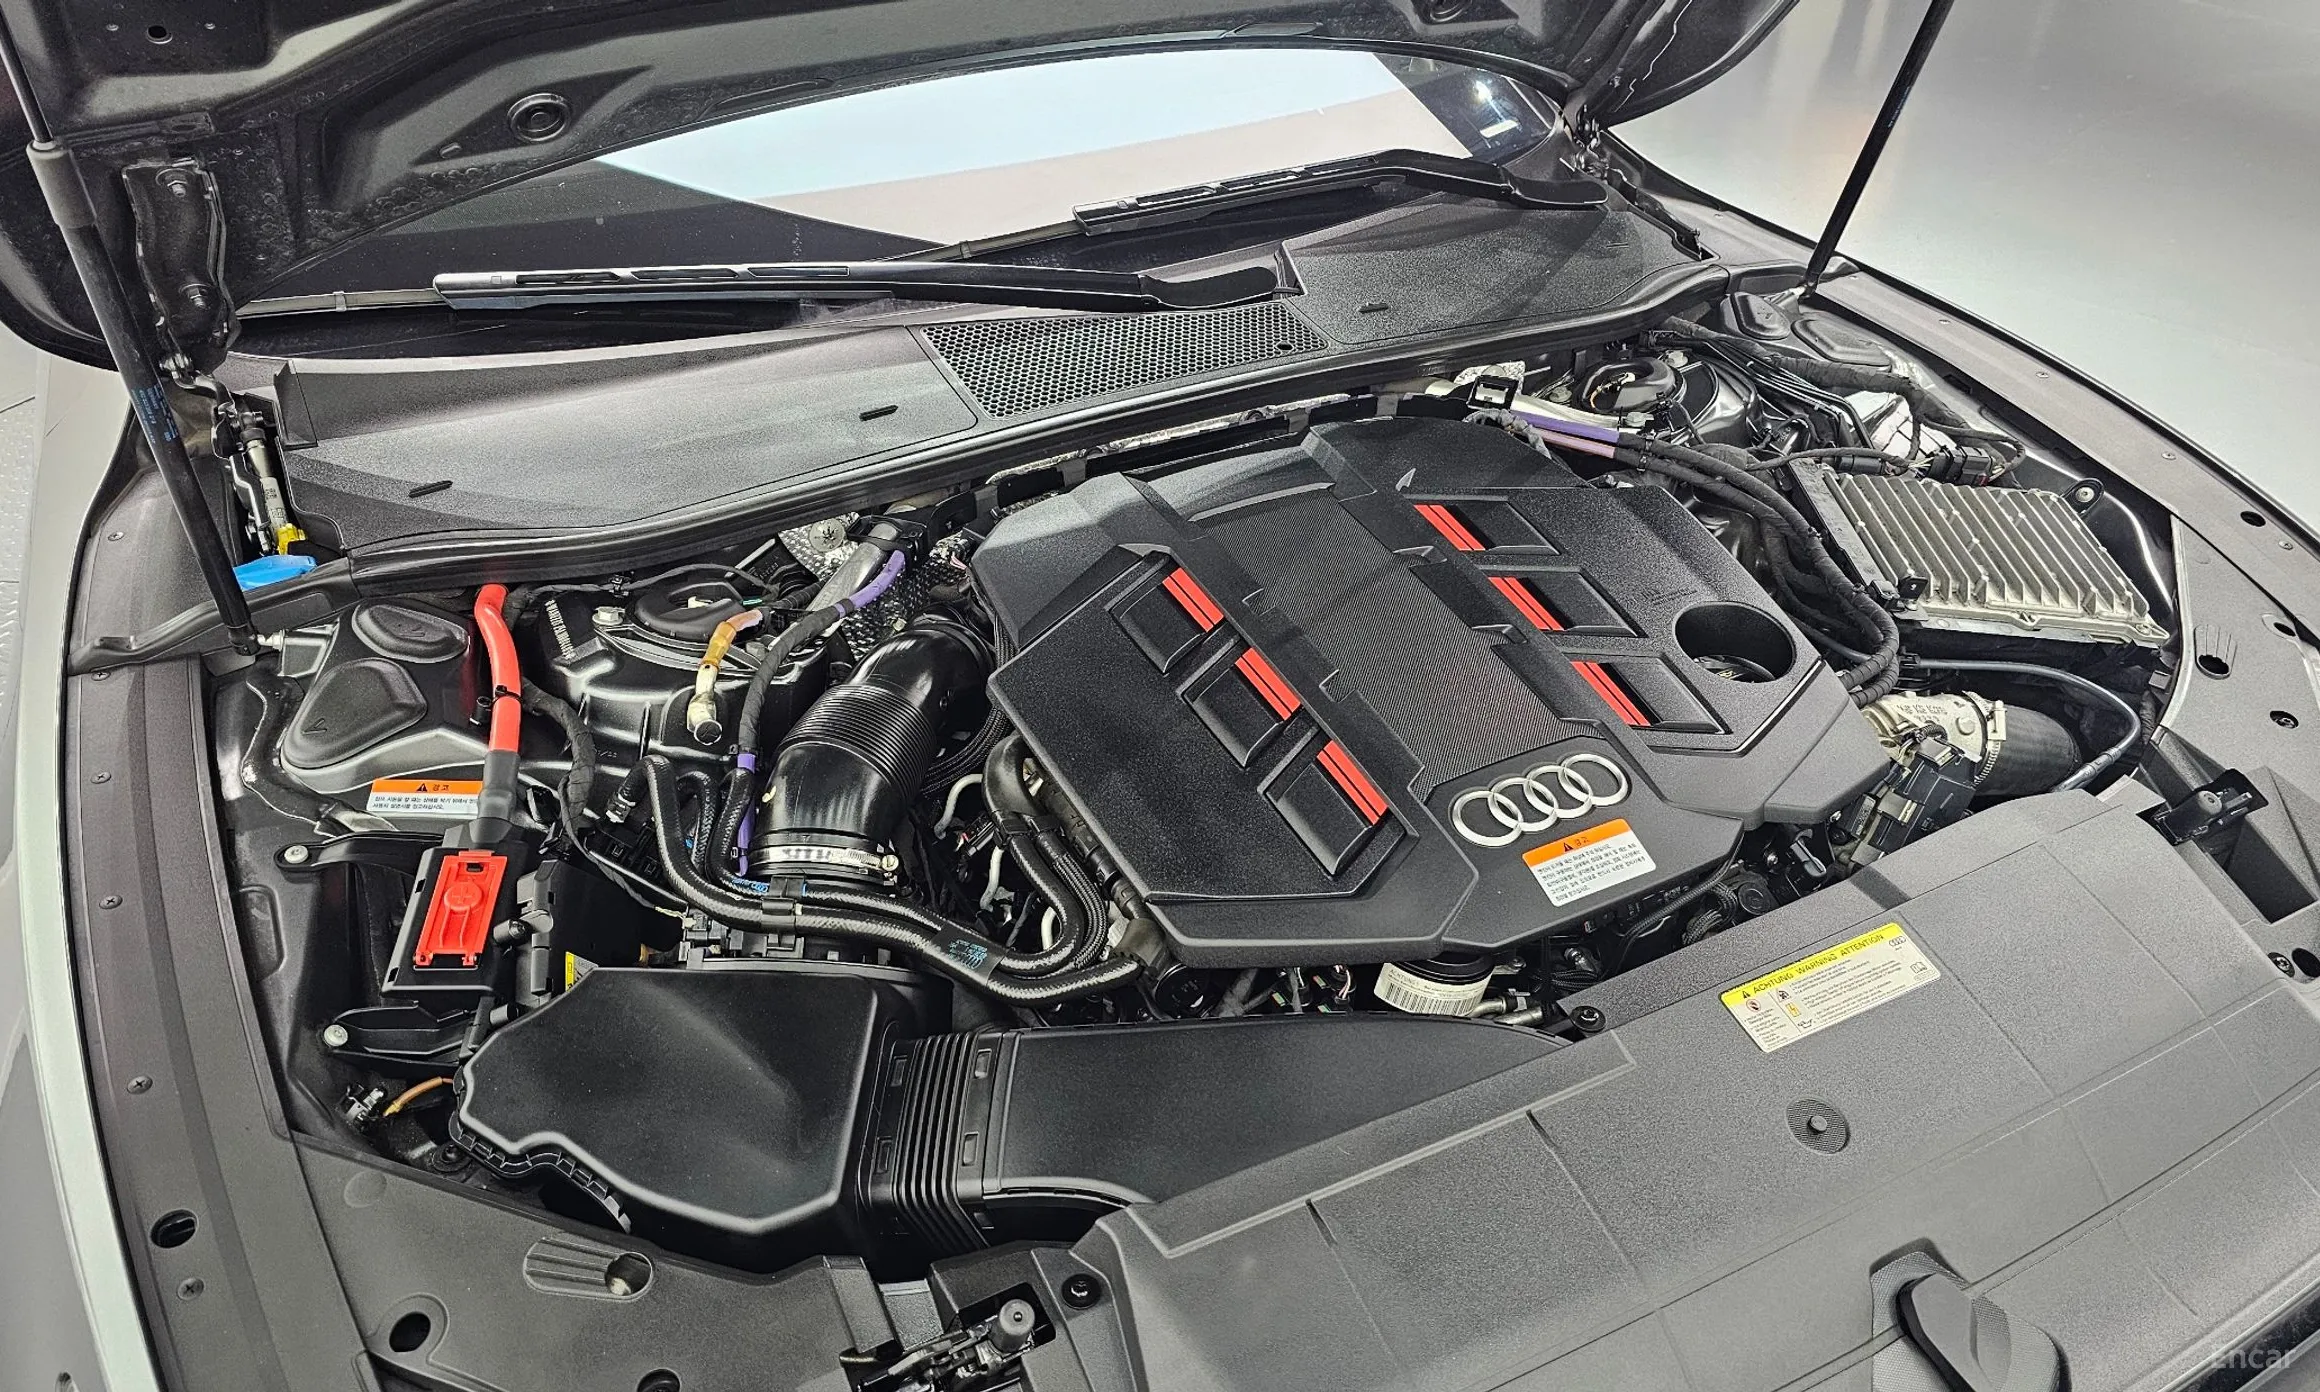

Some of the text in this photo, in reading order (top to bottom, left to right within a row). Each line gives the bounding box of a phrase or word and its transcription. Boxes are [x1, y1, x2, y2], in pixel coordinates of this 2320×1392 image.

[1753, 934, 1884, 994] ACHTUNG WARNING ATTENTION
